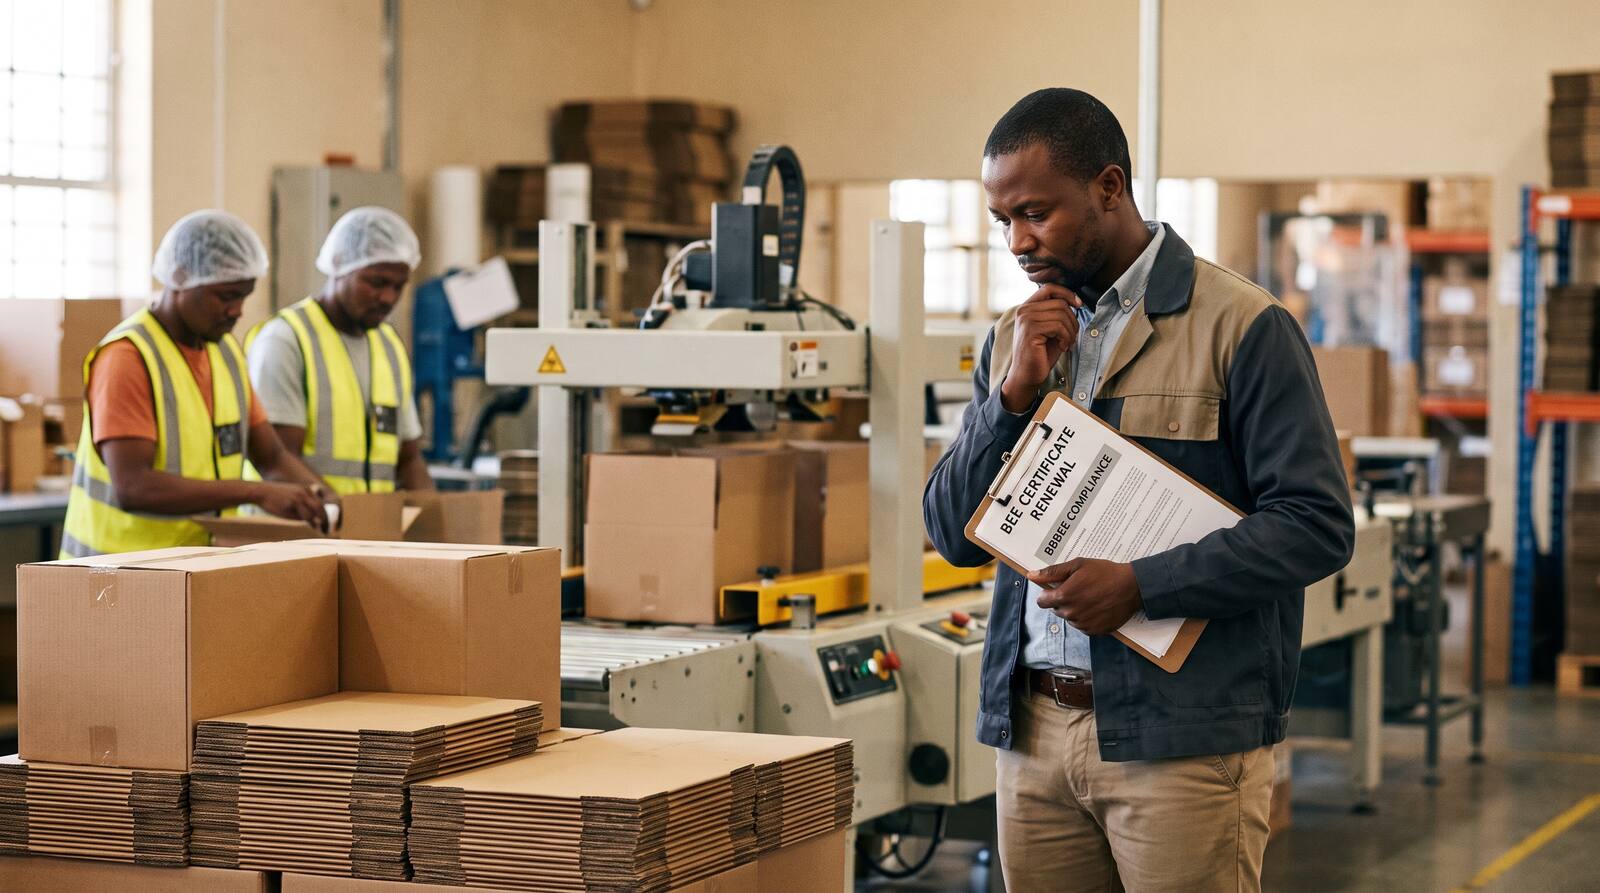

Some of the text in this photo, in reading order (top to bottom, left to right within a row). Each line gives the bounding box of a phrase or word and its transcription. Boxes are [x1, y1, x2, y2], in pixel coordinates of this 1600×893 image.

[1000, 506, 1023, 535] BEE
[1018, 426, 1076, 506] CERTIFICATE
[1030, 460, 1077, 521] RENEWAL
[1043, 520, 1071, 557] BBBEE
[1066, 453, 1113, 521] COMPLIANCE
